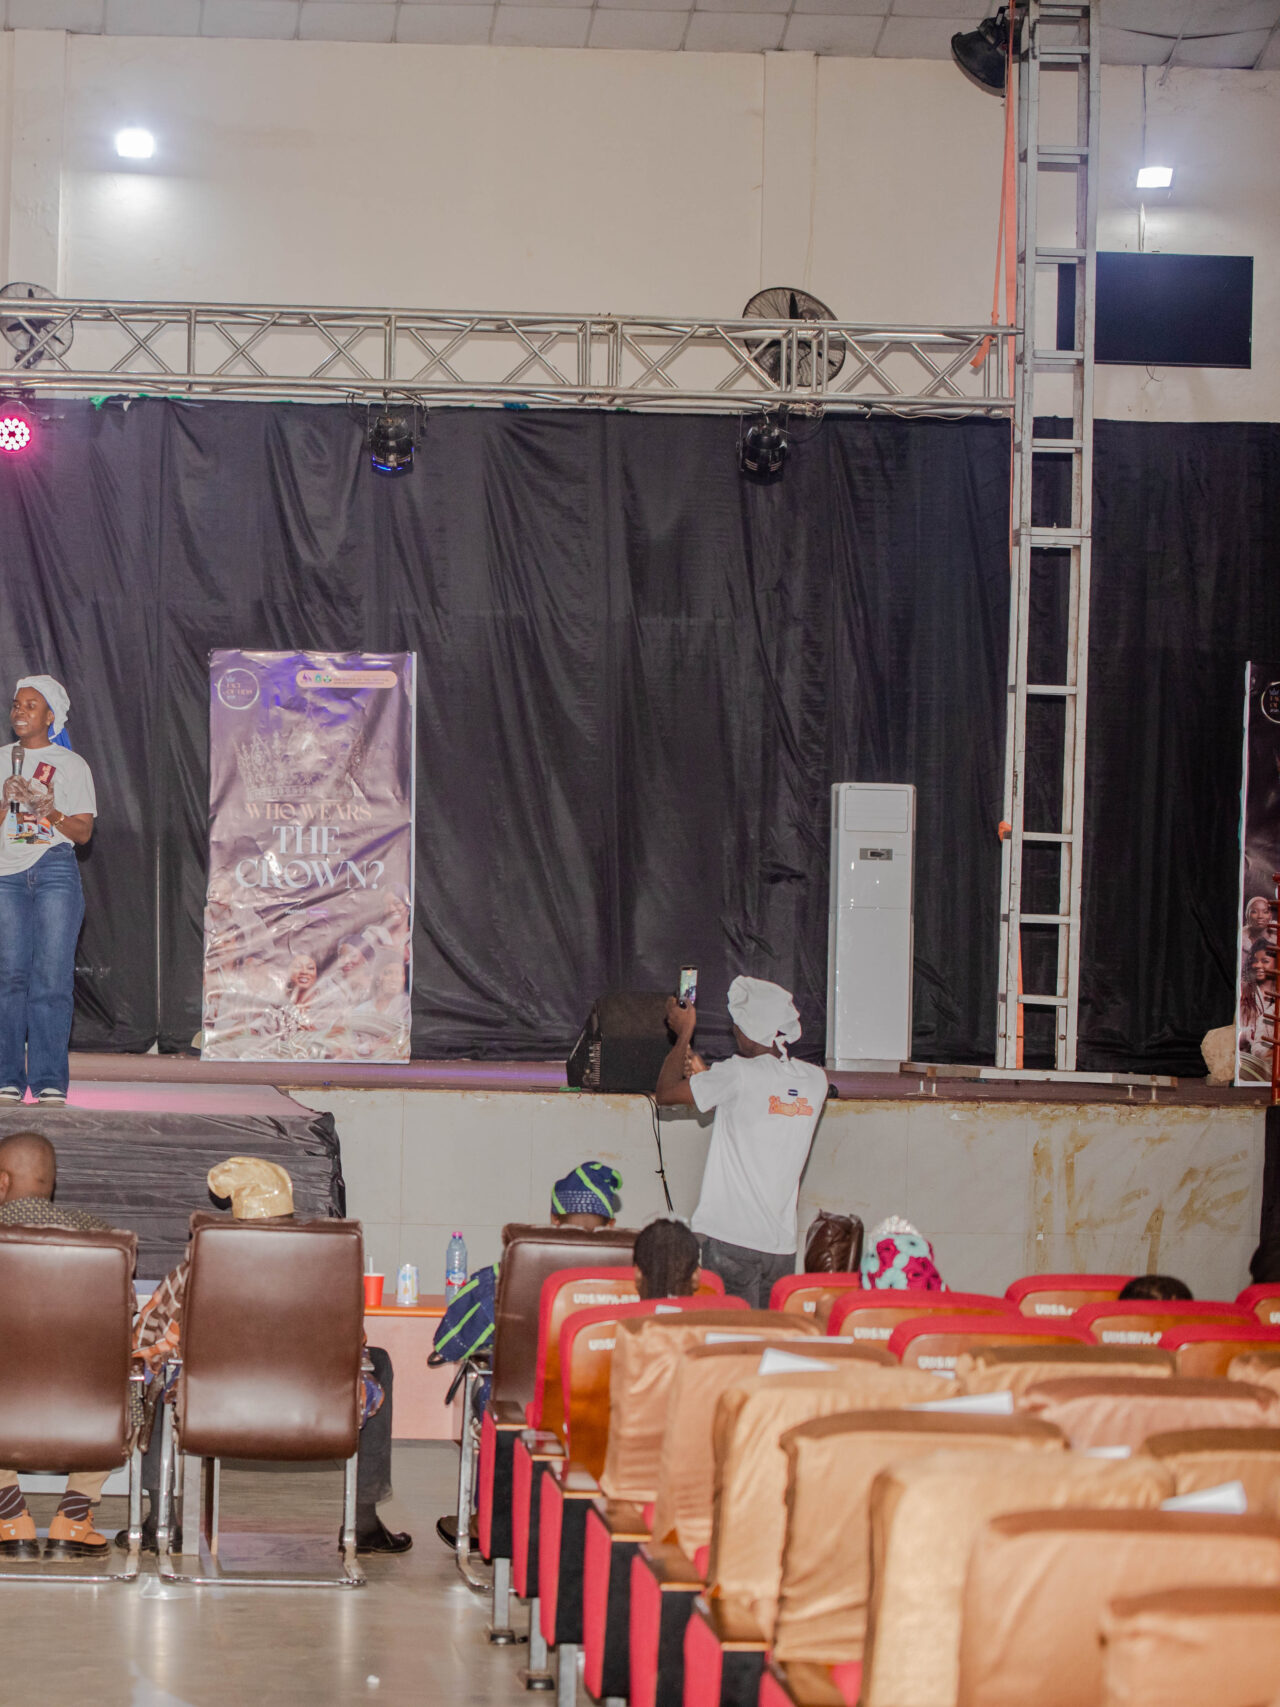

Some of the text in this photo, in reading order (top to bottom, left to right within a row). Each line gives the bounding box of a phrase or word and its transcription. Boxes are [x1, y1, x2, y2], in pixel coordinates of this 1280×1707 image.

[245, 802, 372, 821] WHO WEARS
[272, 825, 341, 855] THE
[235, 859, 385, 890] CROWN?
